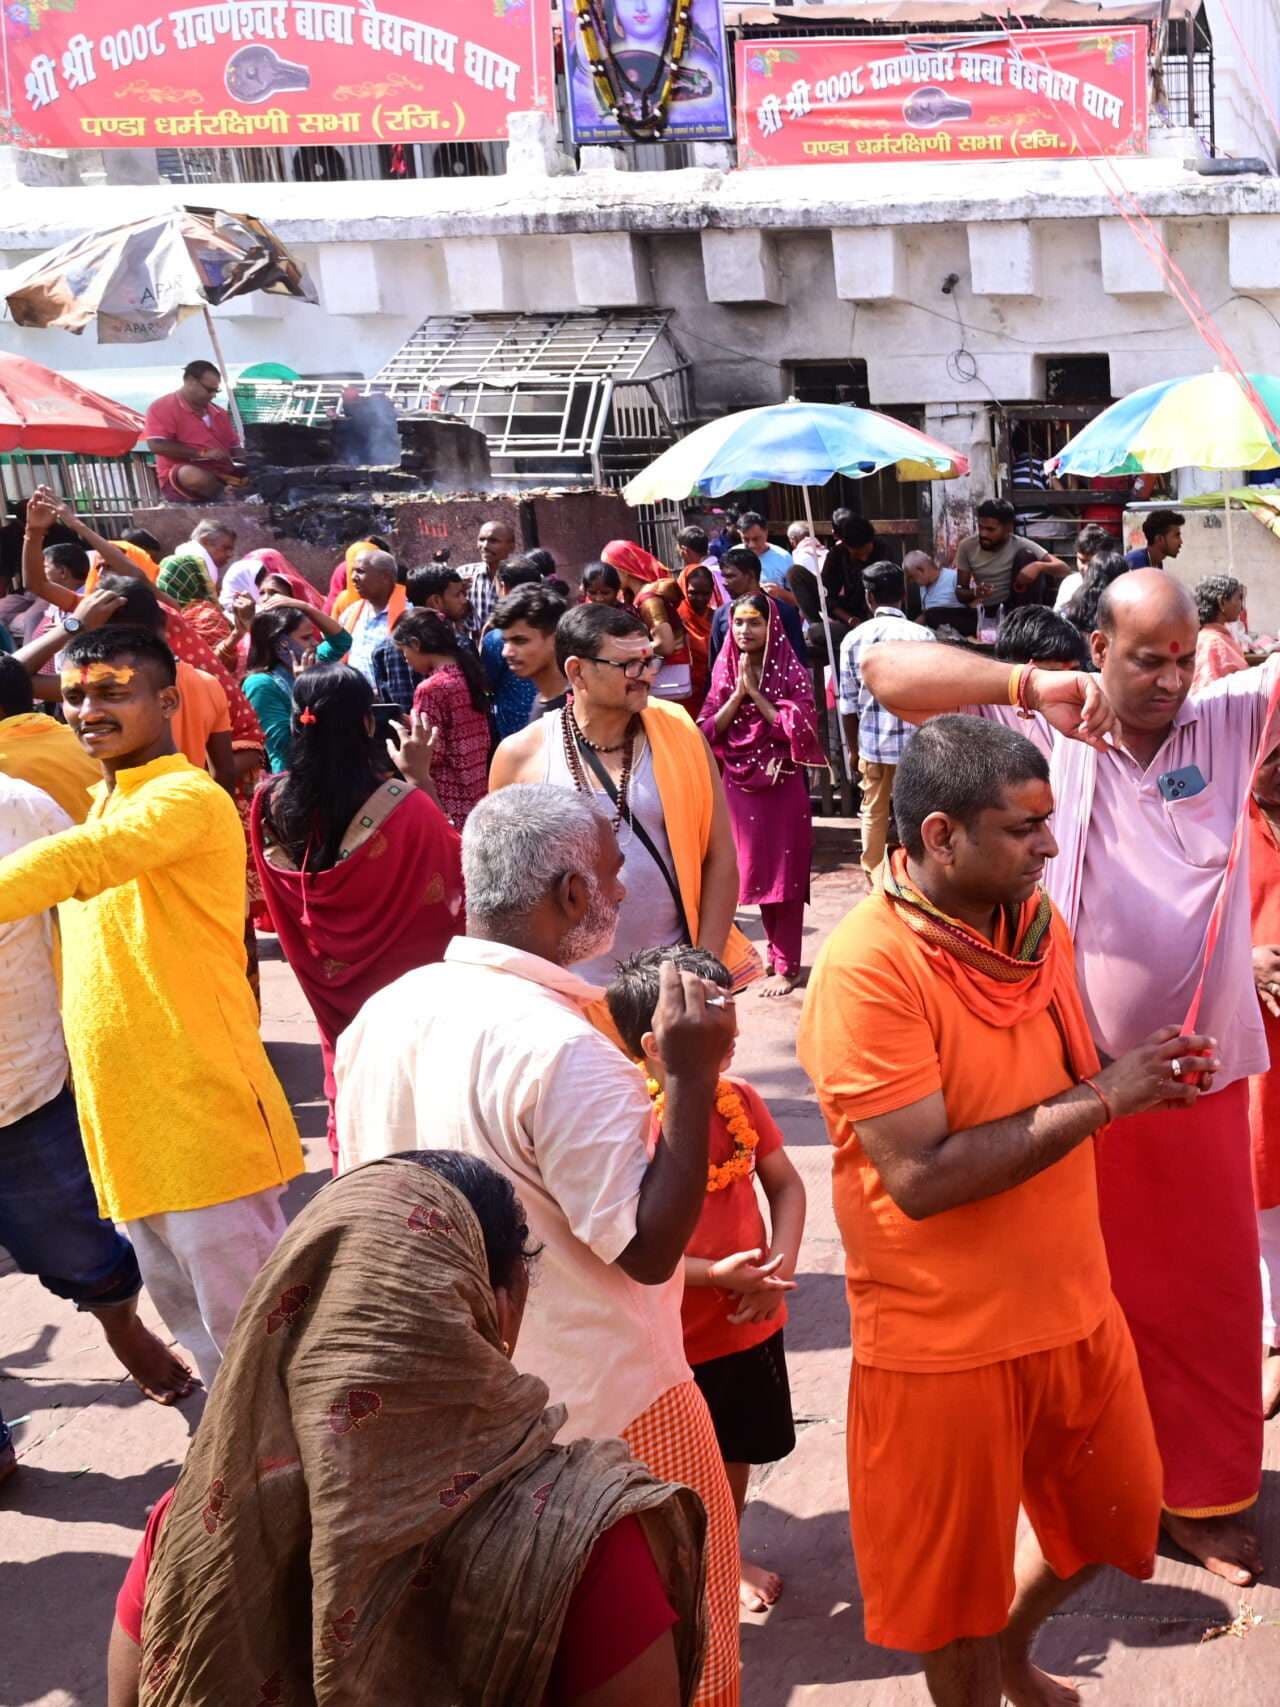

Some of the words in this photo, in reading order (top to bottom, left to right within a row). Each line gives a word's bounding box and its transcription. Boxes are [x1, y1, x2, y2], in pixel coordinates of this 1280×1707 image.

[24, 54, 60, 111] श्री
[62, 33, 97, 90] श्री
[291, 0, 355, 47] बाबा
[464, 40, 521, 102] धाम
[756, 94, 783, 138] श्री
[786, 79, 812, 120] श्री
[956, 53, 1005, 86] बाबा
[1082, 81, 1123, 129] धाम
[80, 116, 147, 137] पण्डा
[297, 112, 361, 133] सभा
[802, 140, 850, 156] पण्डा
[958, 135, 1004, 151] सभा
